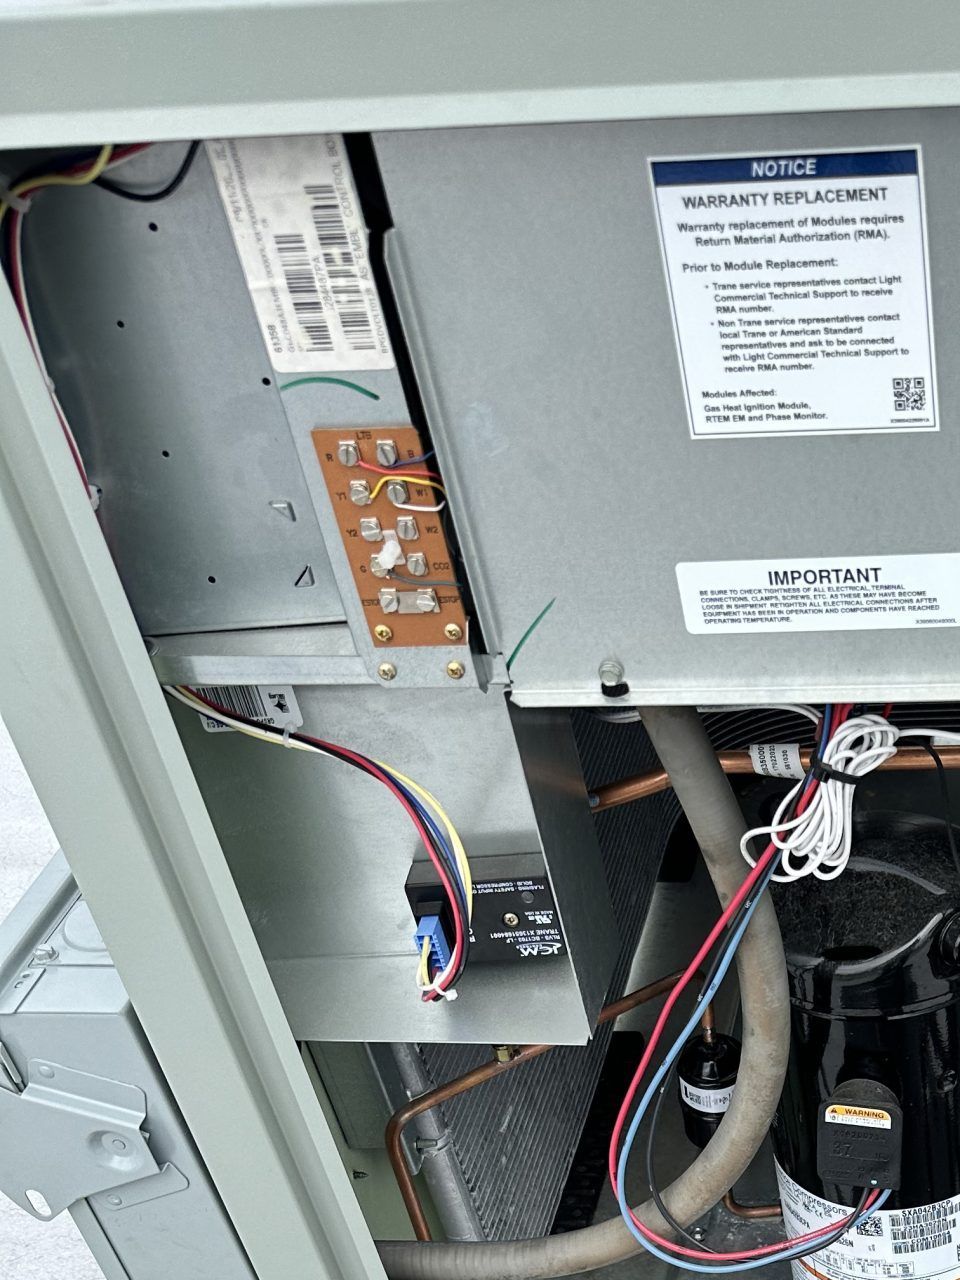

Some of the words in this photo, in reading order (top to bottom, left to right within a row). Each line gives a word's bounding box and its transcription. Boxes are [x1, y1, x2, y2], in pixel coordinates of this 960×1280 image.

[751, 158, 816, 177] NOTICE
[681, 192, 769, 209] WARRANTY
[773, 186, 888, 205] REPLACEMENT
[676, 221, 725, 233] Warranty
[727, 218, 795, 232] replacement
[797, 217, 808, 227] of
[810, 215, 857, 227] Modules
[860, 213, 904, 226] requires
[694, 236, 731, 246] Return
[733, 233, 776, 245] Material
[778, 231, 851, 243] Authorization
[853, 228, 890, 242] (RMA).
[681, 263, 708, 272] Prior
[710, 262, 721, 271] to
[723, 260, 763, 271] Module
[765, 257, 838, 271] Replacement:
[712, 282, 737, 290] Trane
[739, 280, 771, 289] service
[773, 278, 841, 289] representatives
[843, 276, 877, 285] contact
[878, 275, 902, 285] Light
[713, 292, 766, 302] Commercial
[767, 290, 810, 300] Technical
[812, 289, 848, 299] Support
[849, 289, 859, 297] to
[861, 287, 893, 296] receive
[715, 305, 737, 314] RMA
[738, 304, 773, 313] number.
[701, 390, 737, 398] Modules
[739, 388, 776, 397] Affected:
[703, 404, 721, 412] Gas
[743, 403, 775, 413] Ignition
[777, 401, 811, 410] Module,
[705, 415, 730, 423] RTEM
[732, 414, 746, 422] EM
[765, 413, 791, 421] Phase
[793, 412, 827, 420] Monitor.
[326, 453, 334, 462] R
[416, 488, 428, 497] W1
[346, 529, 358, 537] Y2
[425, 526, 439, 534] W2
[360, 565, 367, 573] G
[768, 567, 881, 585] IMPORTANT
[844, 1108, 884, 1119] WARNING
